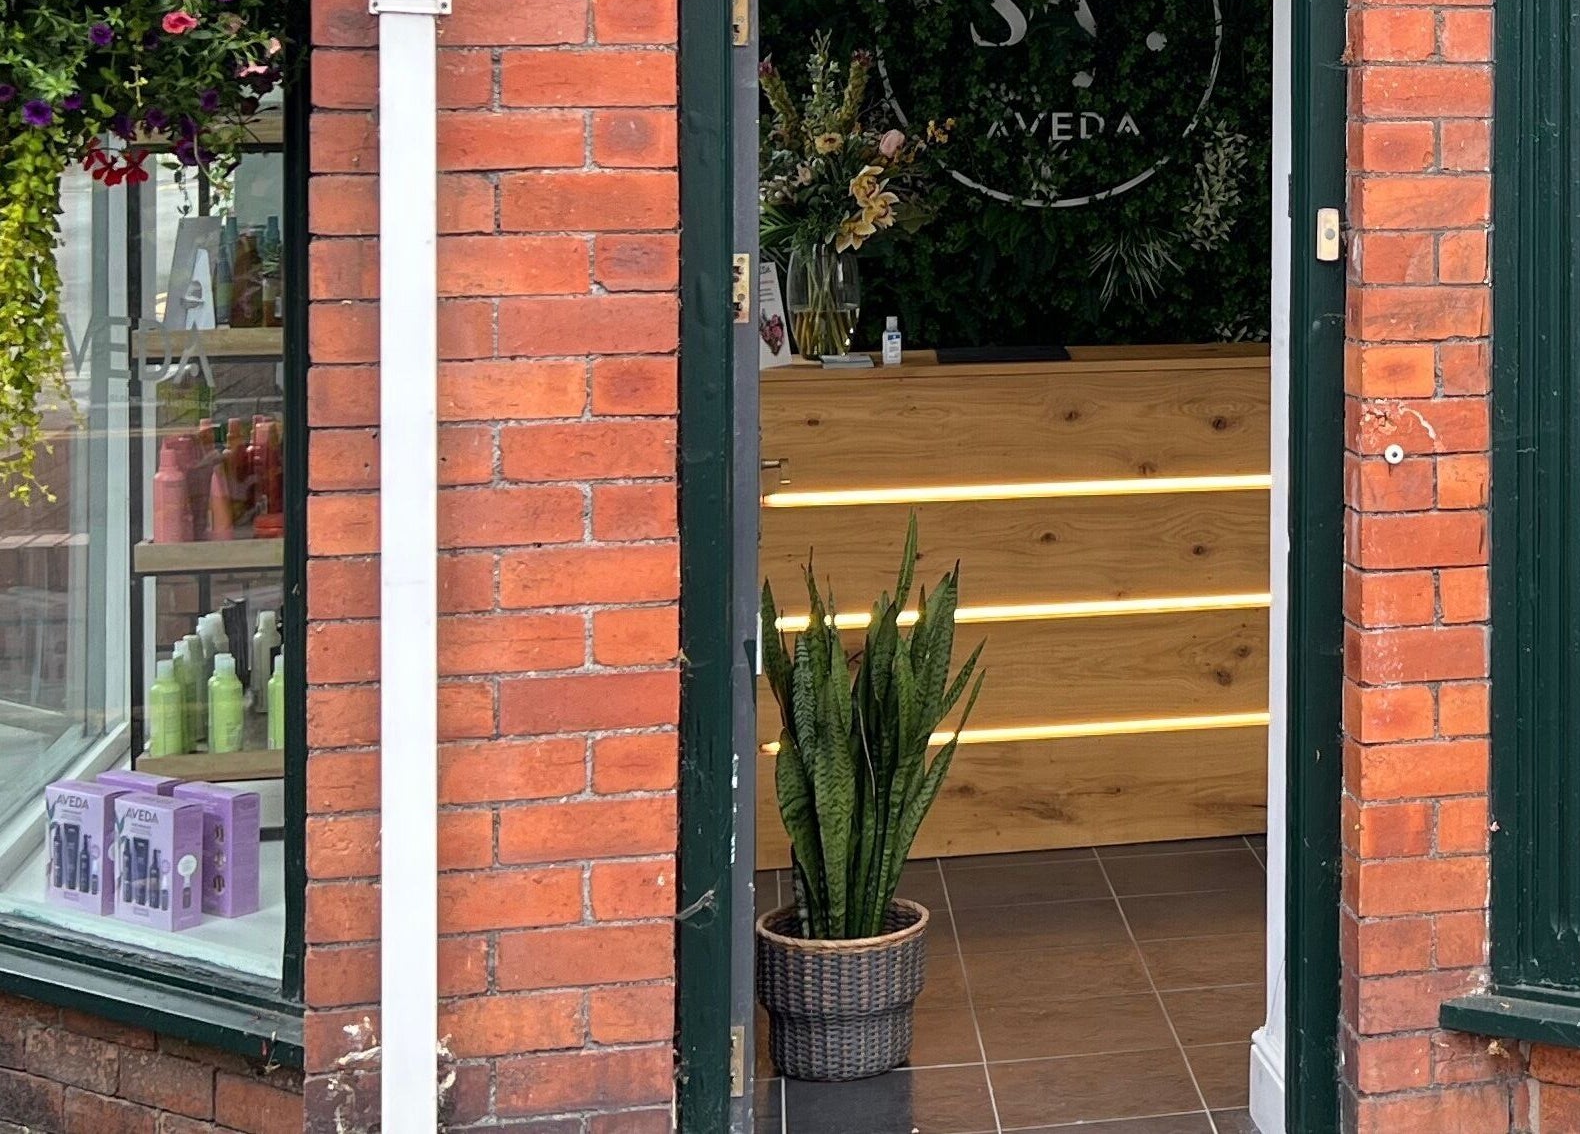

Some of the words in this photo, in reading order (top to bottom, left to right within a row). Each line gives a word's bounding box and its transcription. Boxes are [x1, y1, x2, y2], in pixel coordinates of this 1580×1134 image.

[986, 112, 1142, 141] AVEDA
[62, 313, 216, 387] VEDA
[56, 794, 89, 809] AVEDA
[125, 808, 159, 824] AVEDA
